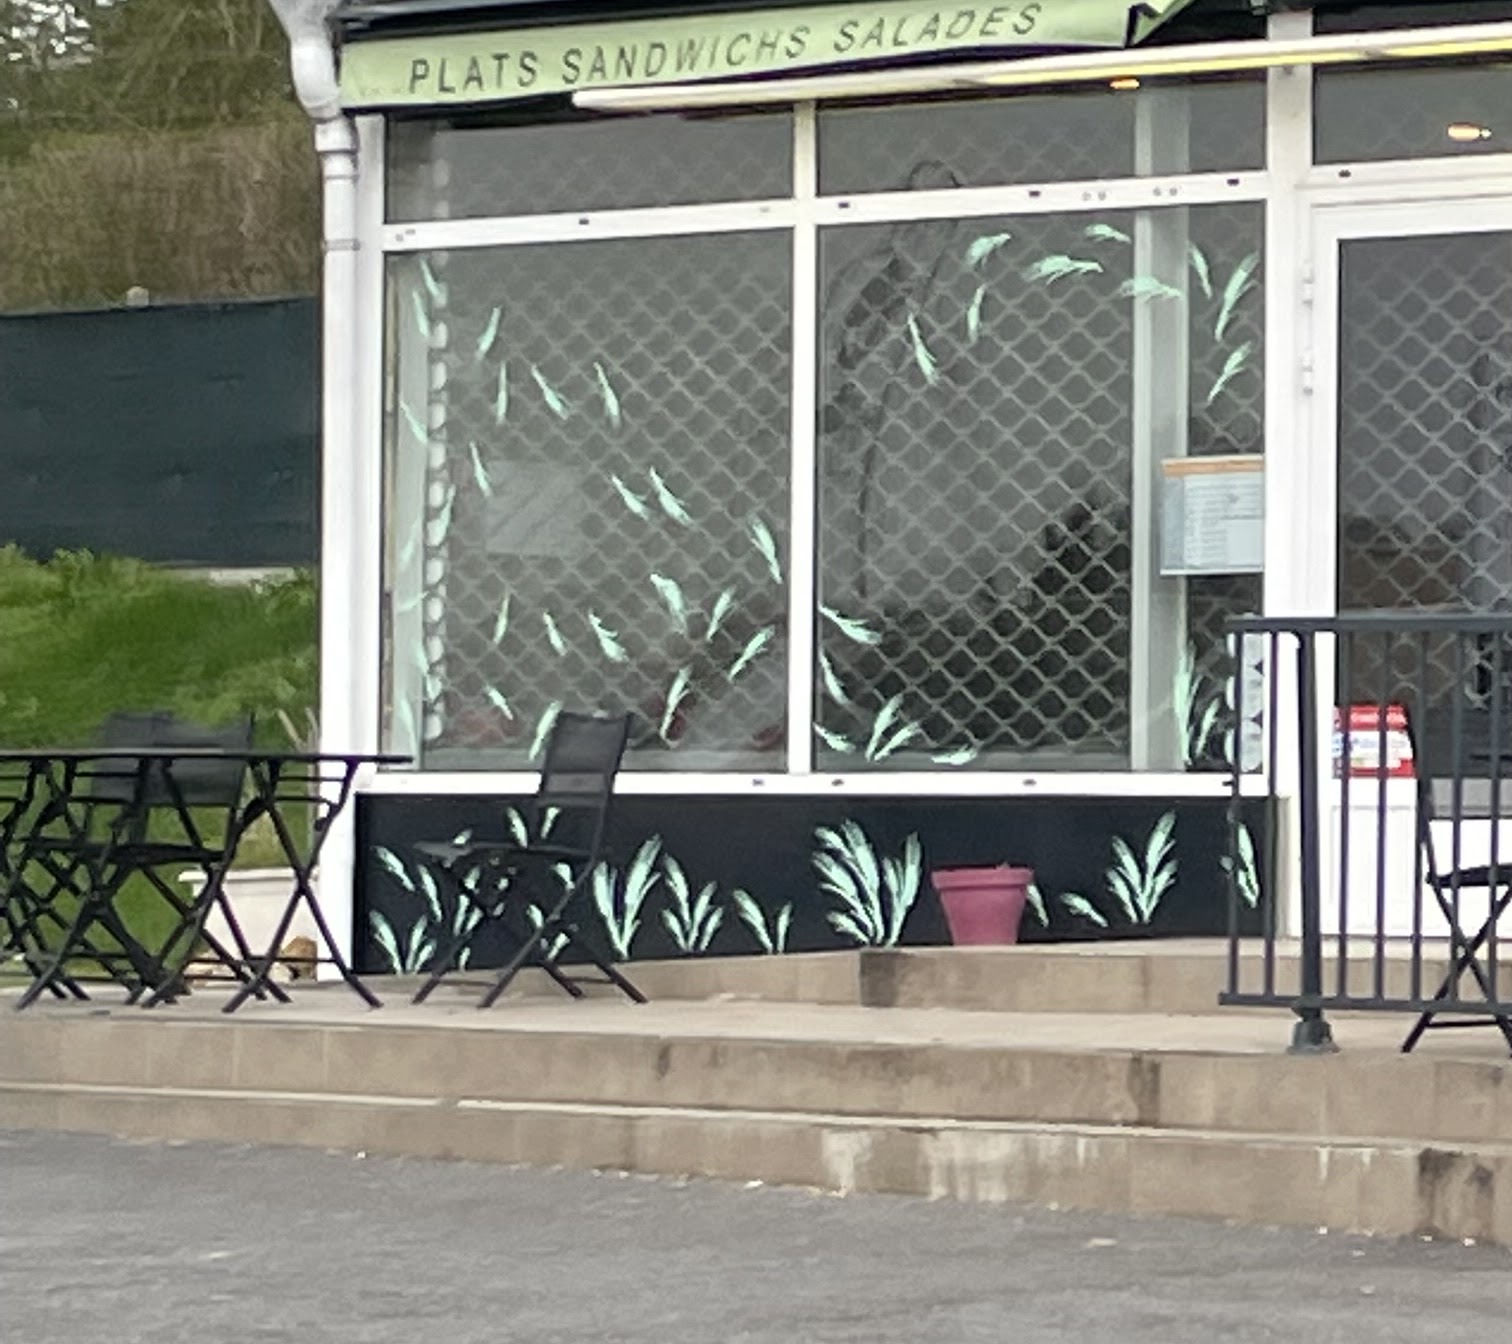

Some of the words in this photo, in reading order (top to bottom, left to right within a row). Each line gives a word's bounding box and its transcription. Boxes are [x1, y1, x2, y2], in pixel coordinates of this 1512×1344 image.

[408, 50, 538, 94] PLATS
[561, 24, 811, 85] SANDWICHS
[832, 2, 1043, 53] SALADES
